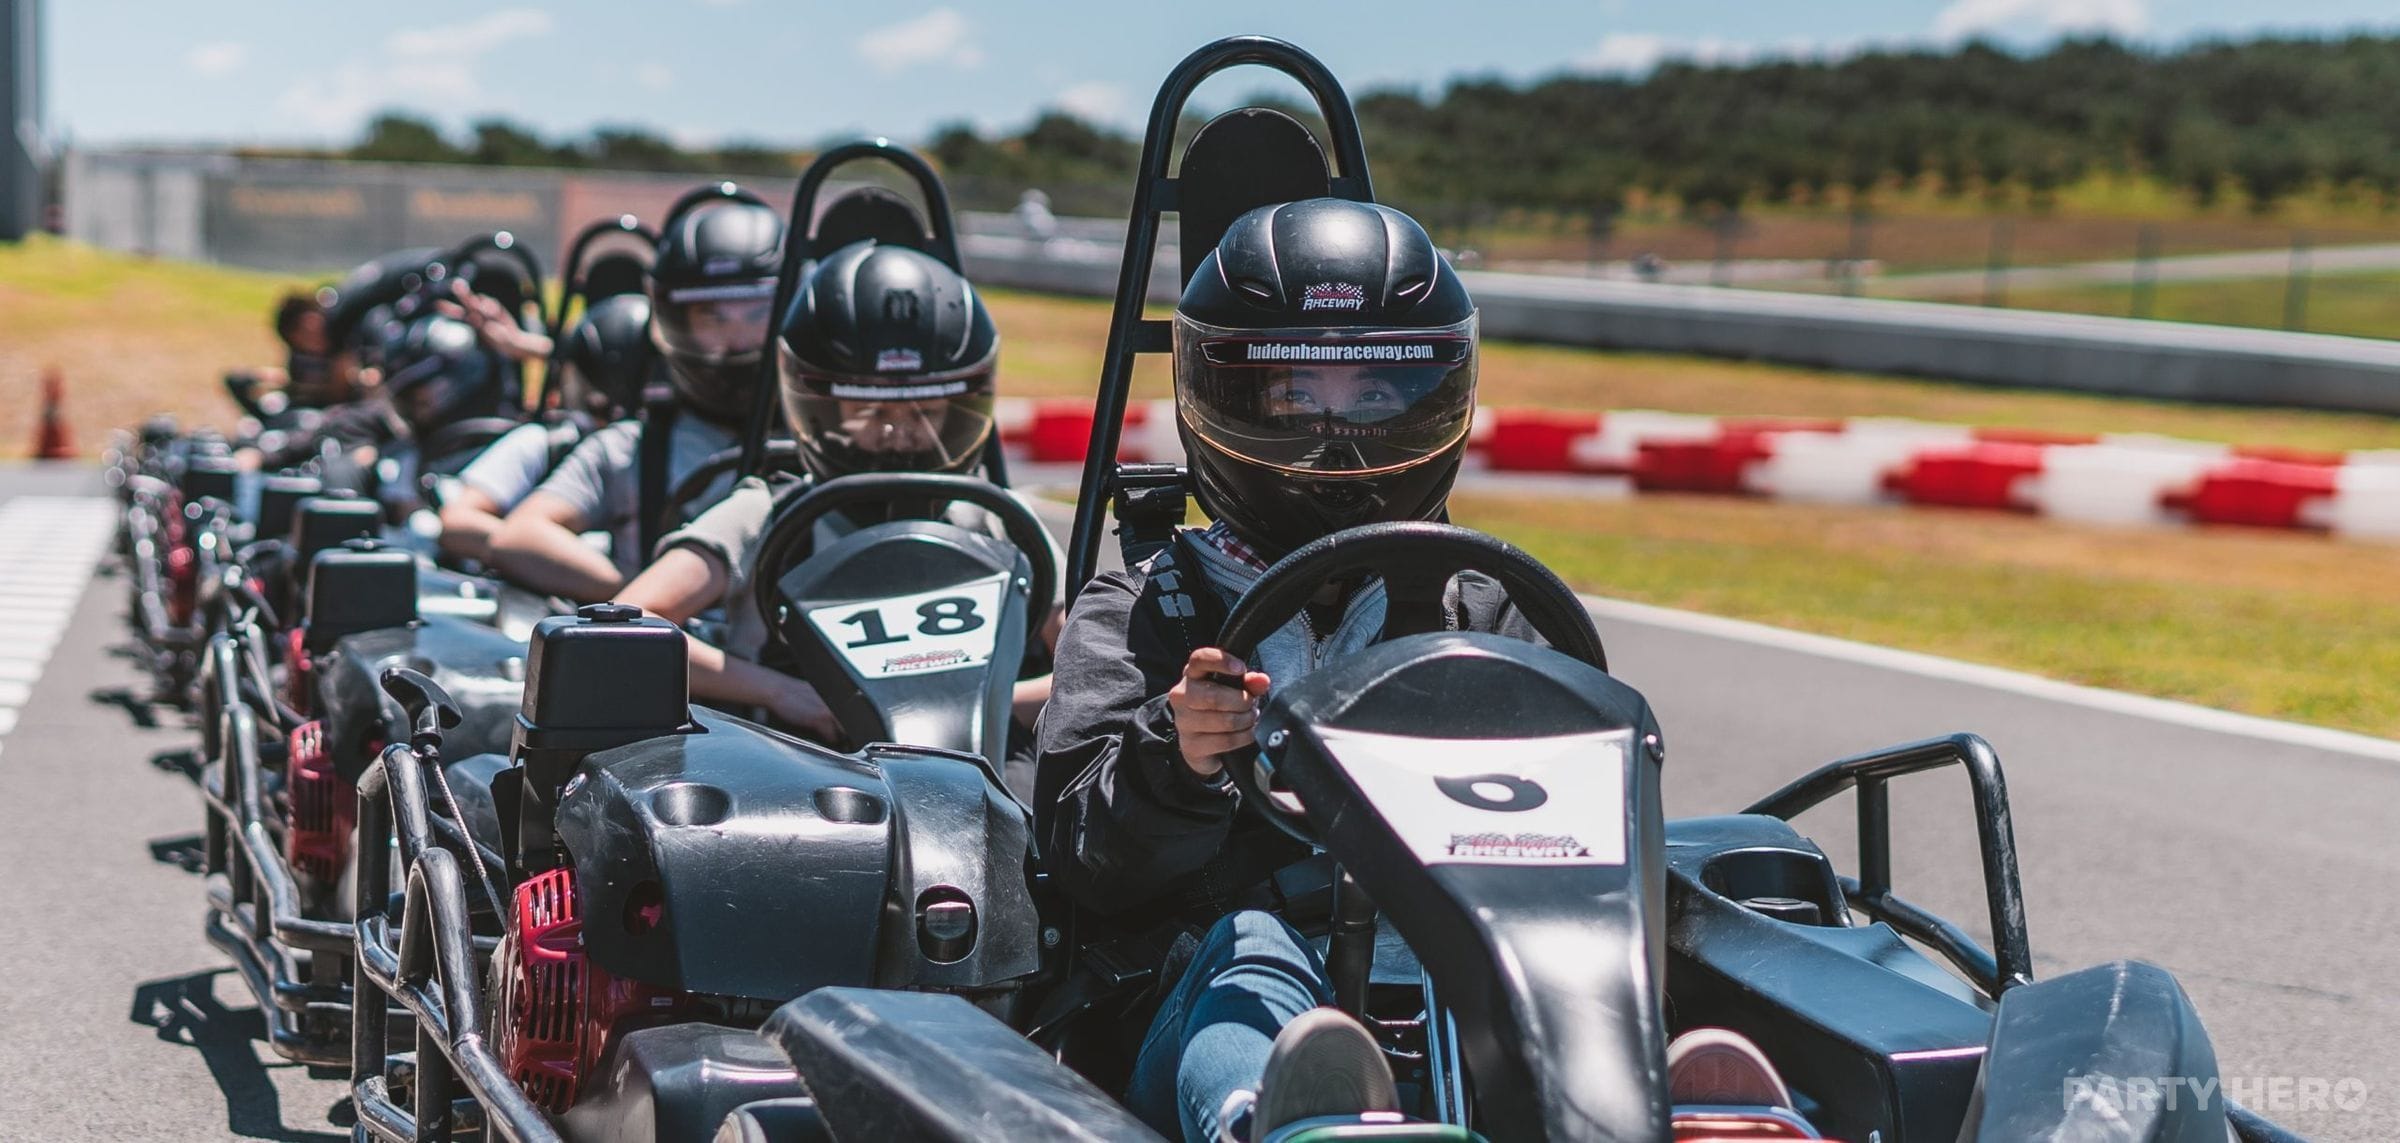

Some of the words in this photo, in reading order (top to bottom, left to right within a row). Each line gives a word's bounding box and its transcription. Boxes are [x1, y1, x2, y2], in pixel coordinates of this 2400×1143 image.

[1302, 298, 1365, 311] RACEWAY
[1246, 343, 1434, 361] luddenhamraceway.com
[839, 596, 986, 649] 18
[1451, 845, 1584, 858] RACEWAY
